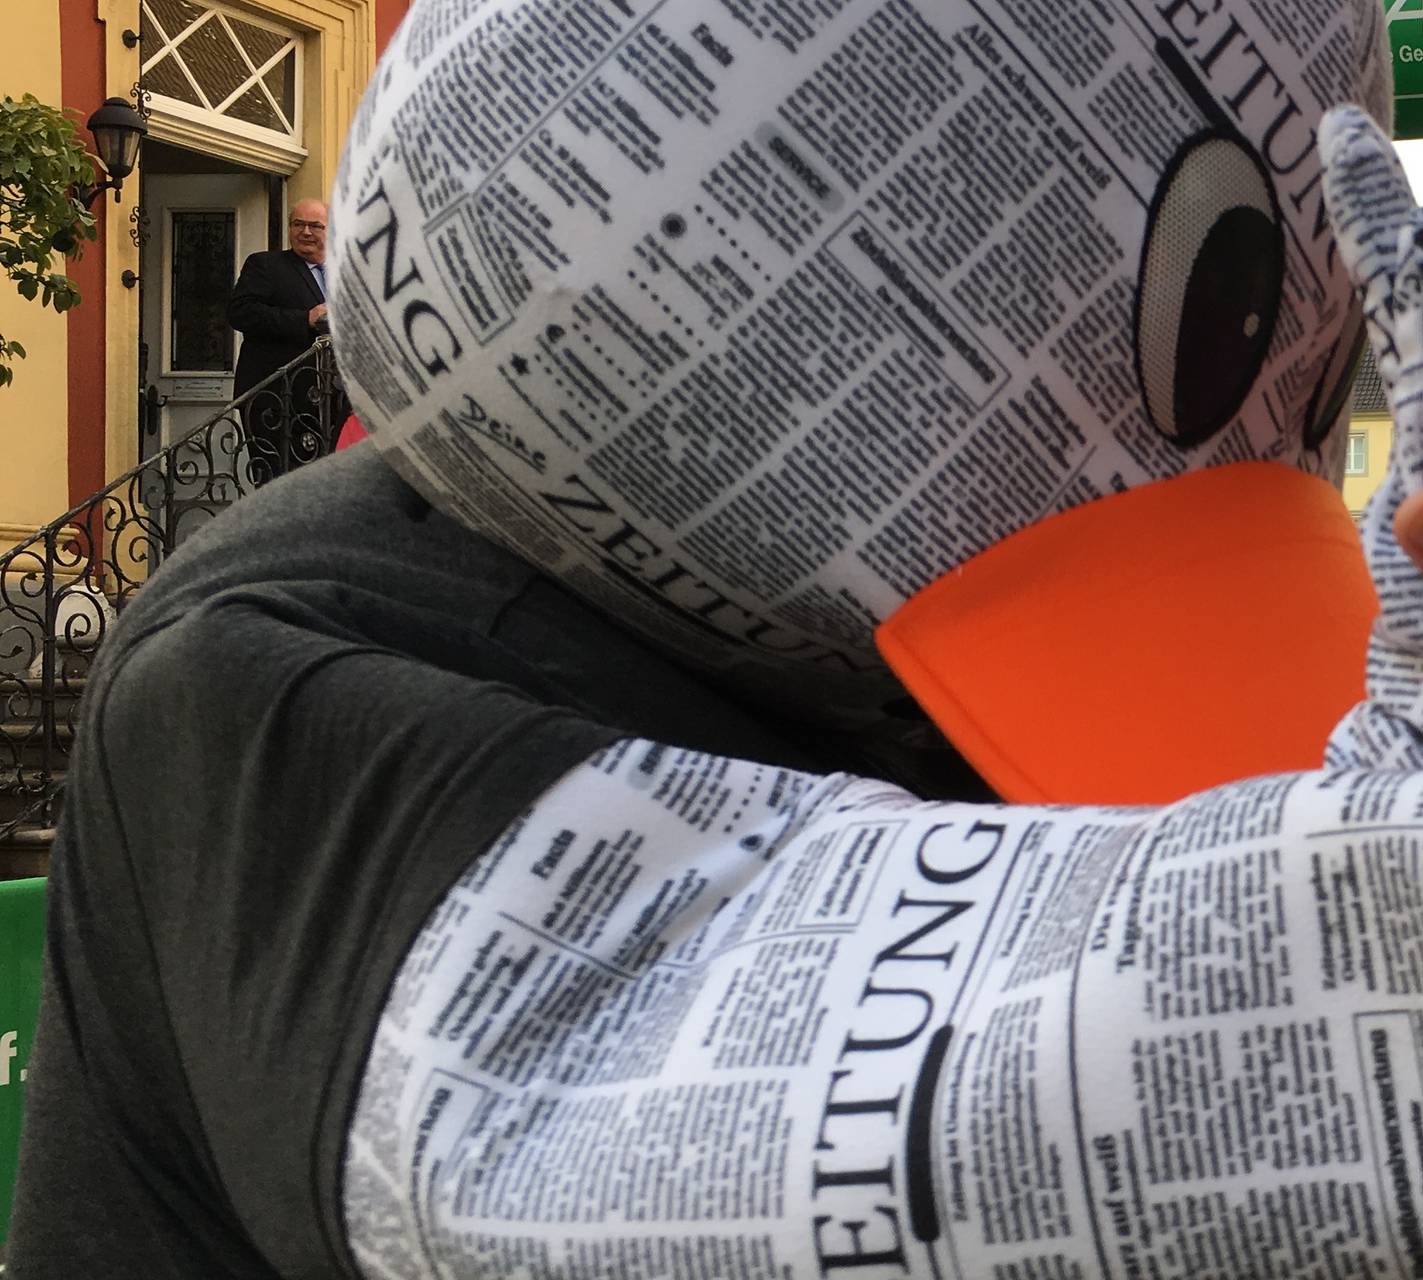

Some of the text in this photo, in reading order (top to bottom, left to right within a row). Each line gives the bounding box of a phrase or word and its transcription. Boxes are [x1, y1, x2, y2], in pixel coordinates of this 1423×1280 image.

[963, 18, 1007, 65] Alles
[999, 59, 1061, 128] schwarz
[1052, 122, 1083, 155] auf
[1160, 0, 1336, 270] EITUN
[460, 394, 547, 470] Deine
[1090, 1134, 1122, 1193] weiß
[1102, 1198, 1130, 1237] auf
